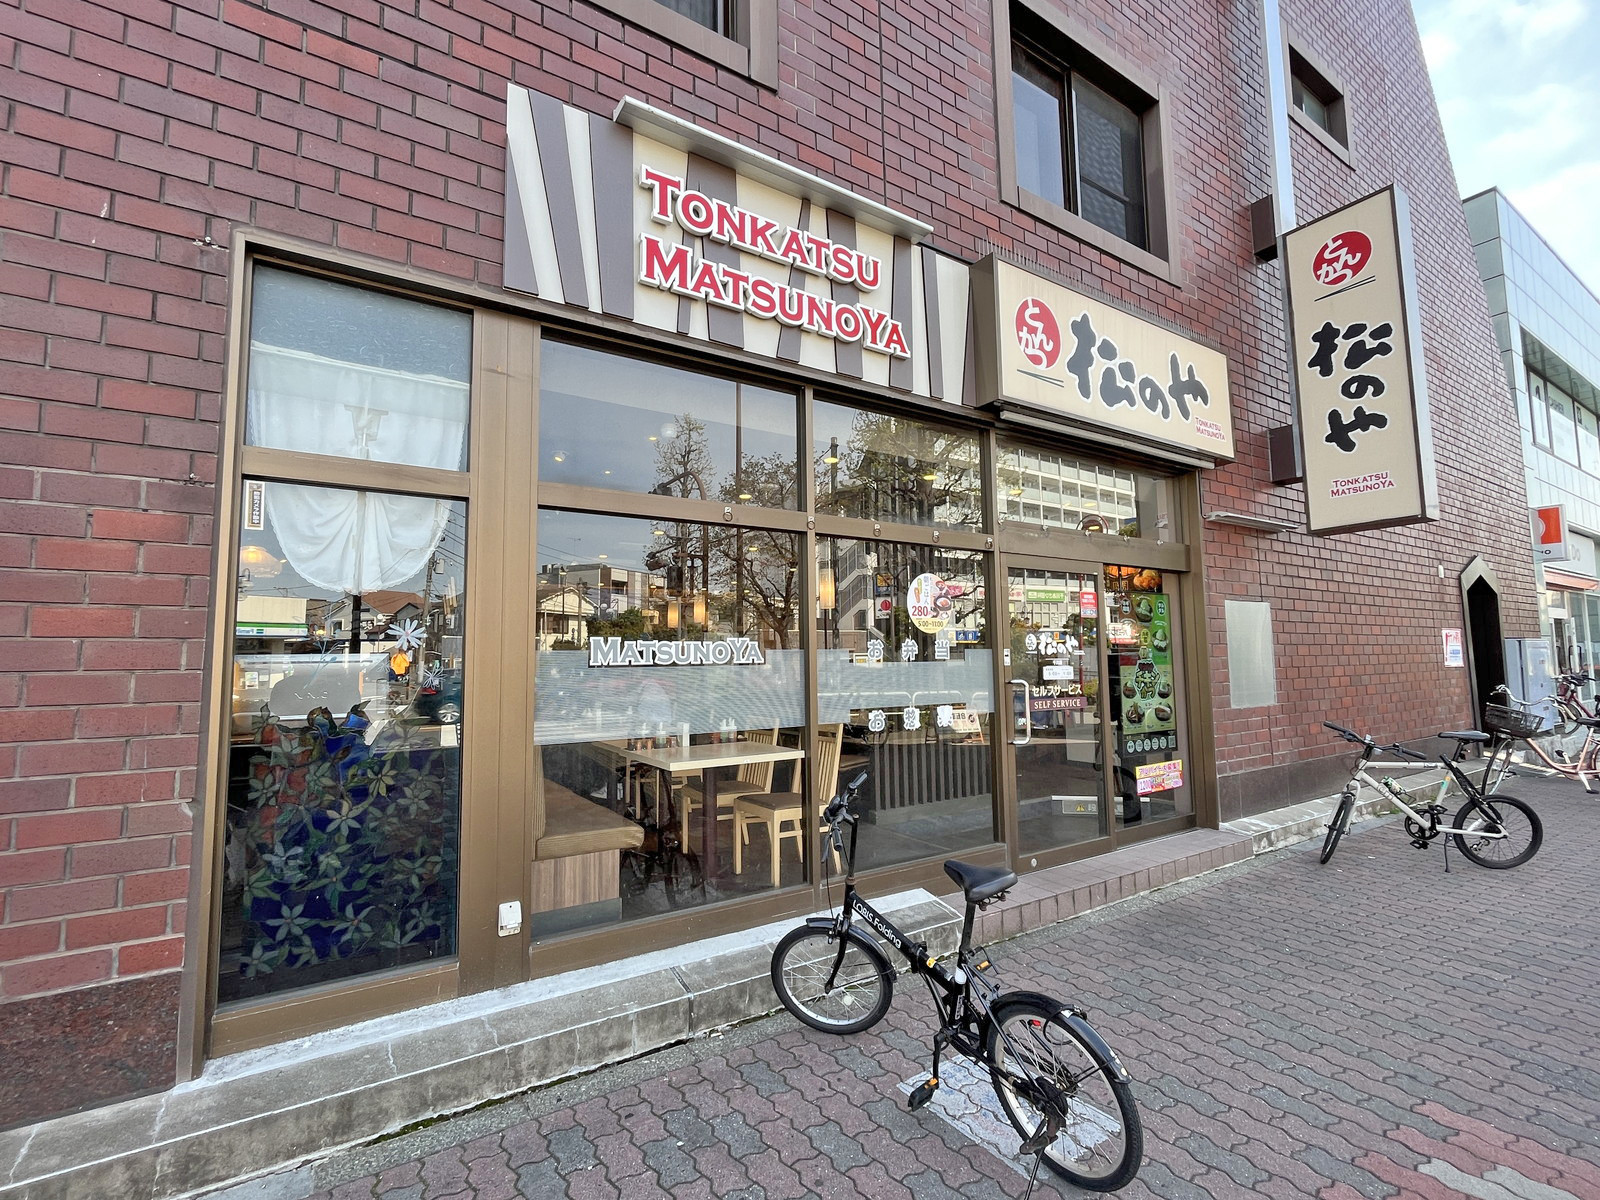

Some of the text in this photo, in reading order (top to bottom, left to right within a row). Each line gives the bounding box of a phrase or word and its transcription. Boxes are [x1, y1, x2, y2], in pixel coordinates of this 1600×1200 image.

[641, 165, 881, 291] TONKATSU
[1315, 238, 1363, 284] とんかつ
[639, 233, 910, 359] MATSUNOYA
[1016, 297, 1057, 369] とんかつ
[1066, 311, 1210, 422] 松のや
[1307, 321, 1393, 453] 松のや
[1195, 416, 1222, 431] TONKATSU
[1196, 425, 1226, 441] MATSUNOYA
[1330, 480, 1395, 497] MATSUNOYA
[1332, 471, 1389, 488] TONKATSU
[911, 605, 929, 617] 280
[589, 636, 765, 666] MATSUNOYA
[867, 639, 950, 661] お弁当
[1031, 683, 1083, 699] セルフサービス
[1034, 698, 1082, 710] SELF SERVICE
[873, 917, 902, 949] Folding
